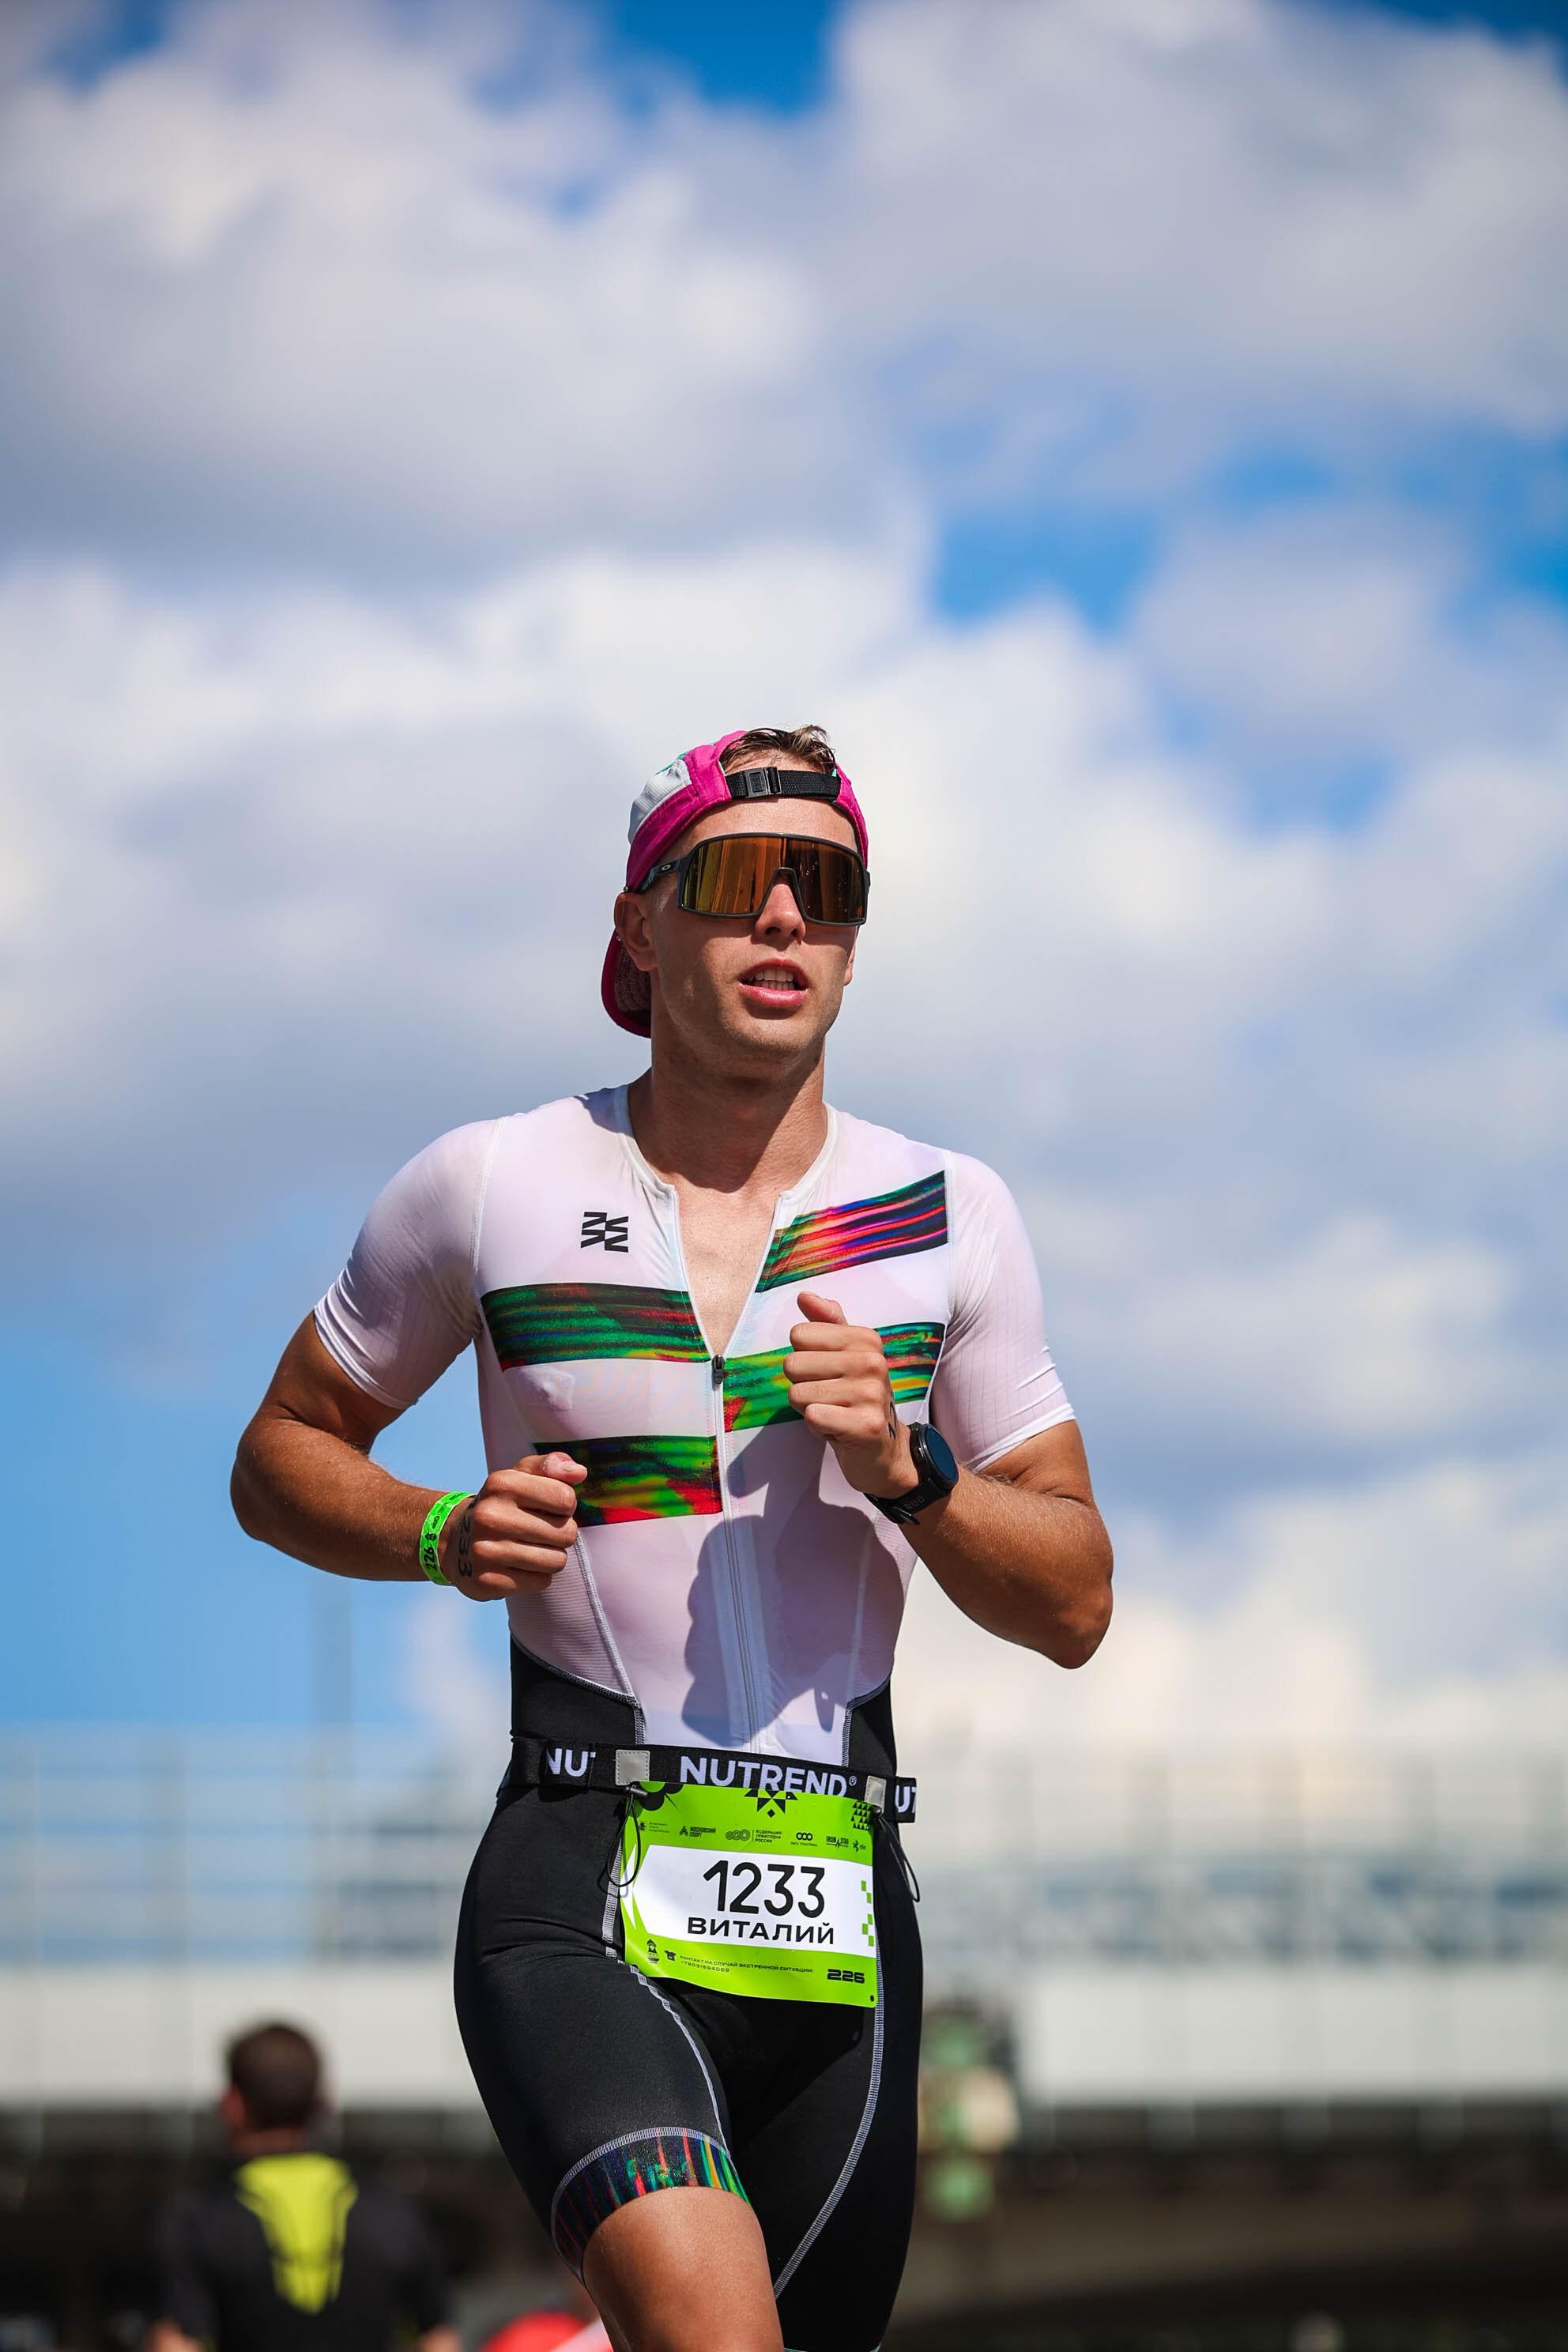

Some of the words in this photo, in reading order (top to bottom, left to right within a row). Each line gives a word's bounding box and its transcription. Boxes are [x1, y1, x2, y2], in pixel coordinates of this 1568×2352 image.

[424, 1546, 437, 1570] 226
[703, 1860, 824, 1918] 1233
[688, 1917, 834, 1944] ВИТАЛИЙ
[680, 1955, 704, 1964] КОНТАКТ
[739, 1962, 778, 1971] ЭКСТРЕННОЙ
[827, 1969, 865, 1984] 226
